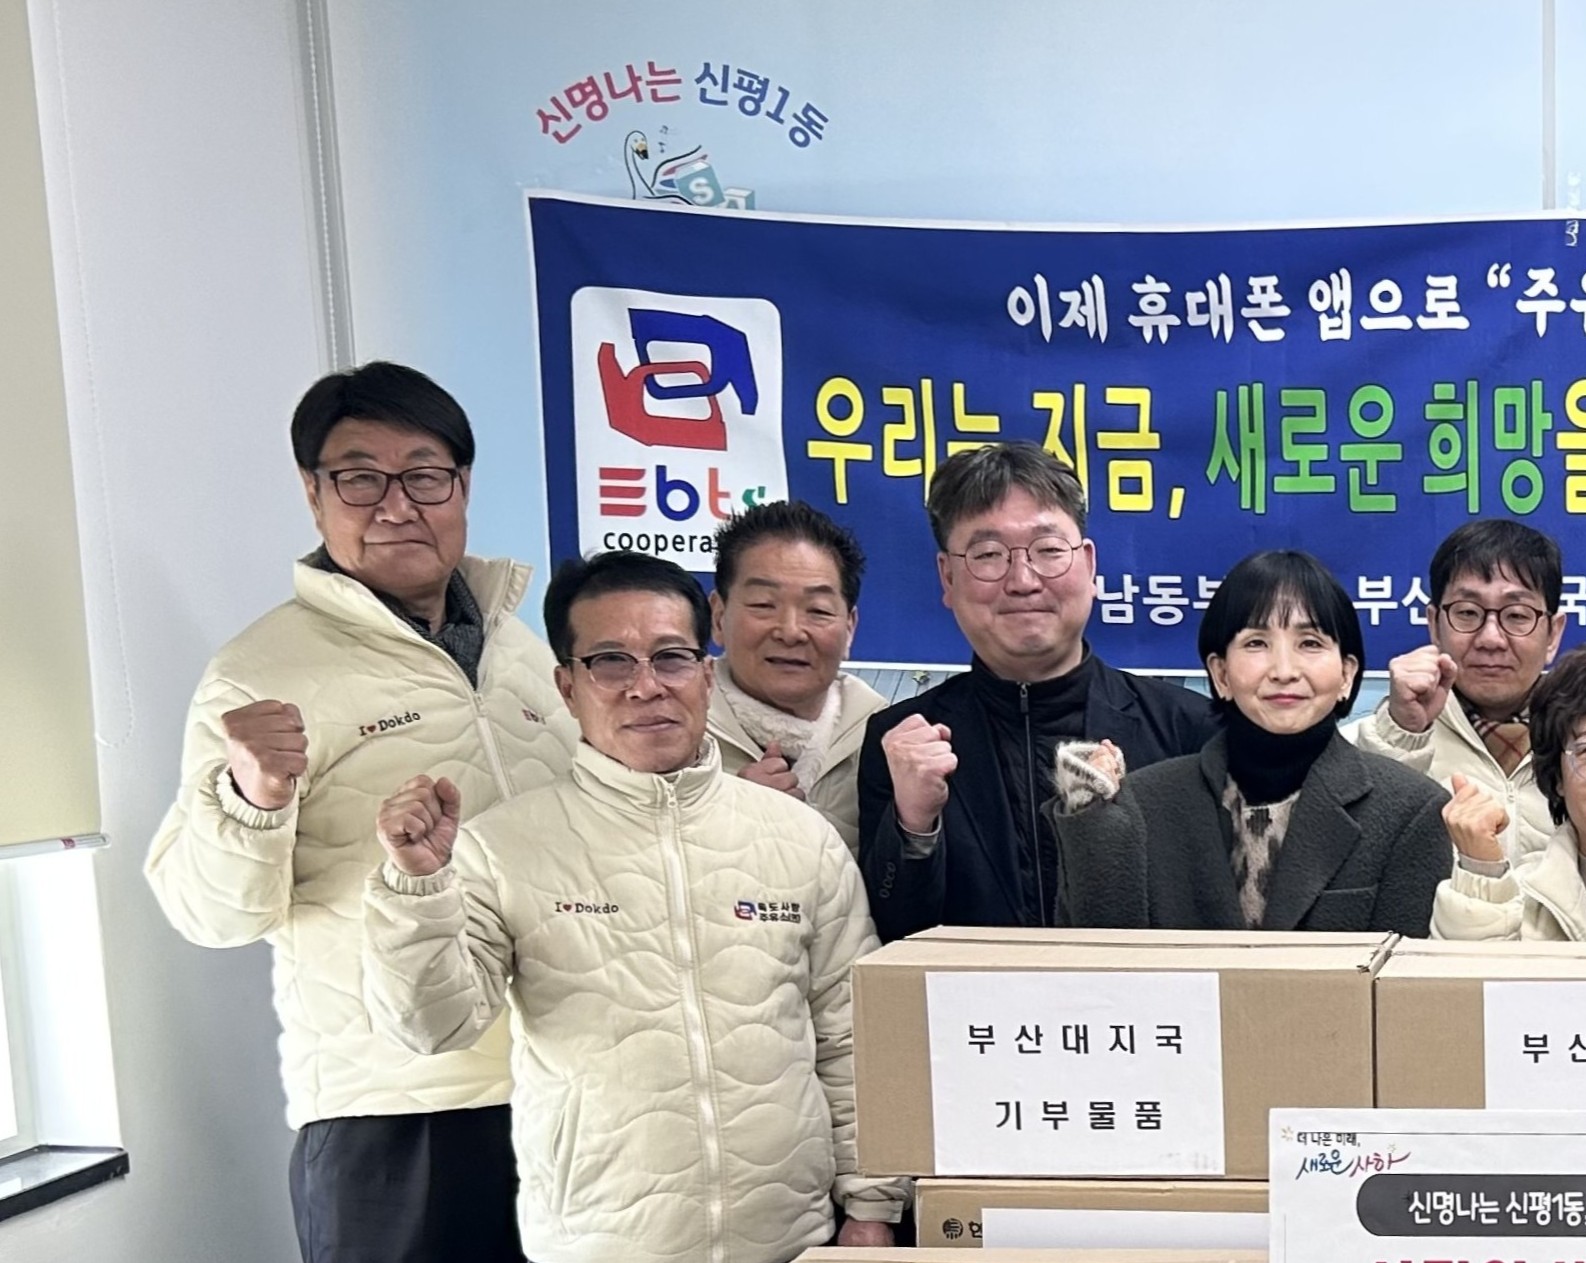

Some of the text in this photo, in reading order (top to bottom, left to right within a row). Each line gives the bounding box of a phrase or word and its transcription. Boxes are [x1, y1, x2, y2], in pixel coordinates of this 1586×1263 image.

[536, 61, 829, 148] 신명나는 신평1동
[1007, 273, 1107, 342] 이제
[1127, 272, 1291, 342] 휴대폰
[1309, 267, 1470, 342] 앱으로
[1032, 383, 1186, 519] 지금,
[1206, 380, 1404, 515] 새로운
[603, 531, 714, 556] coopera
[378, 711, 421, 732] Dokdo
[575, 901, 619, 914] Dokdo
[1310, 1132, 1332, 1147] 나은
[1295, 1149, 1355, 1180] 새로운
[1408, 1191, 1499, 1225] 신명나는
